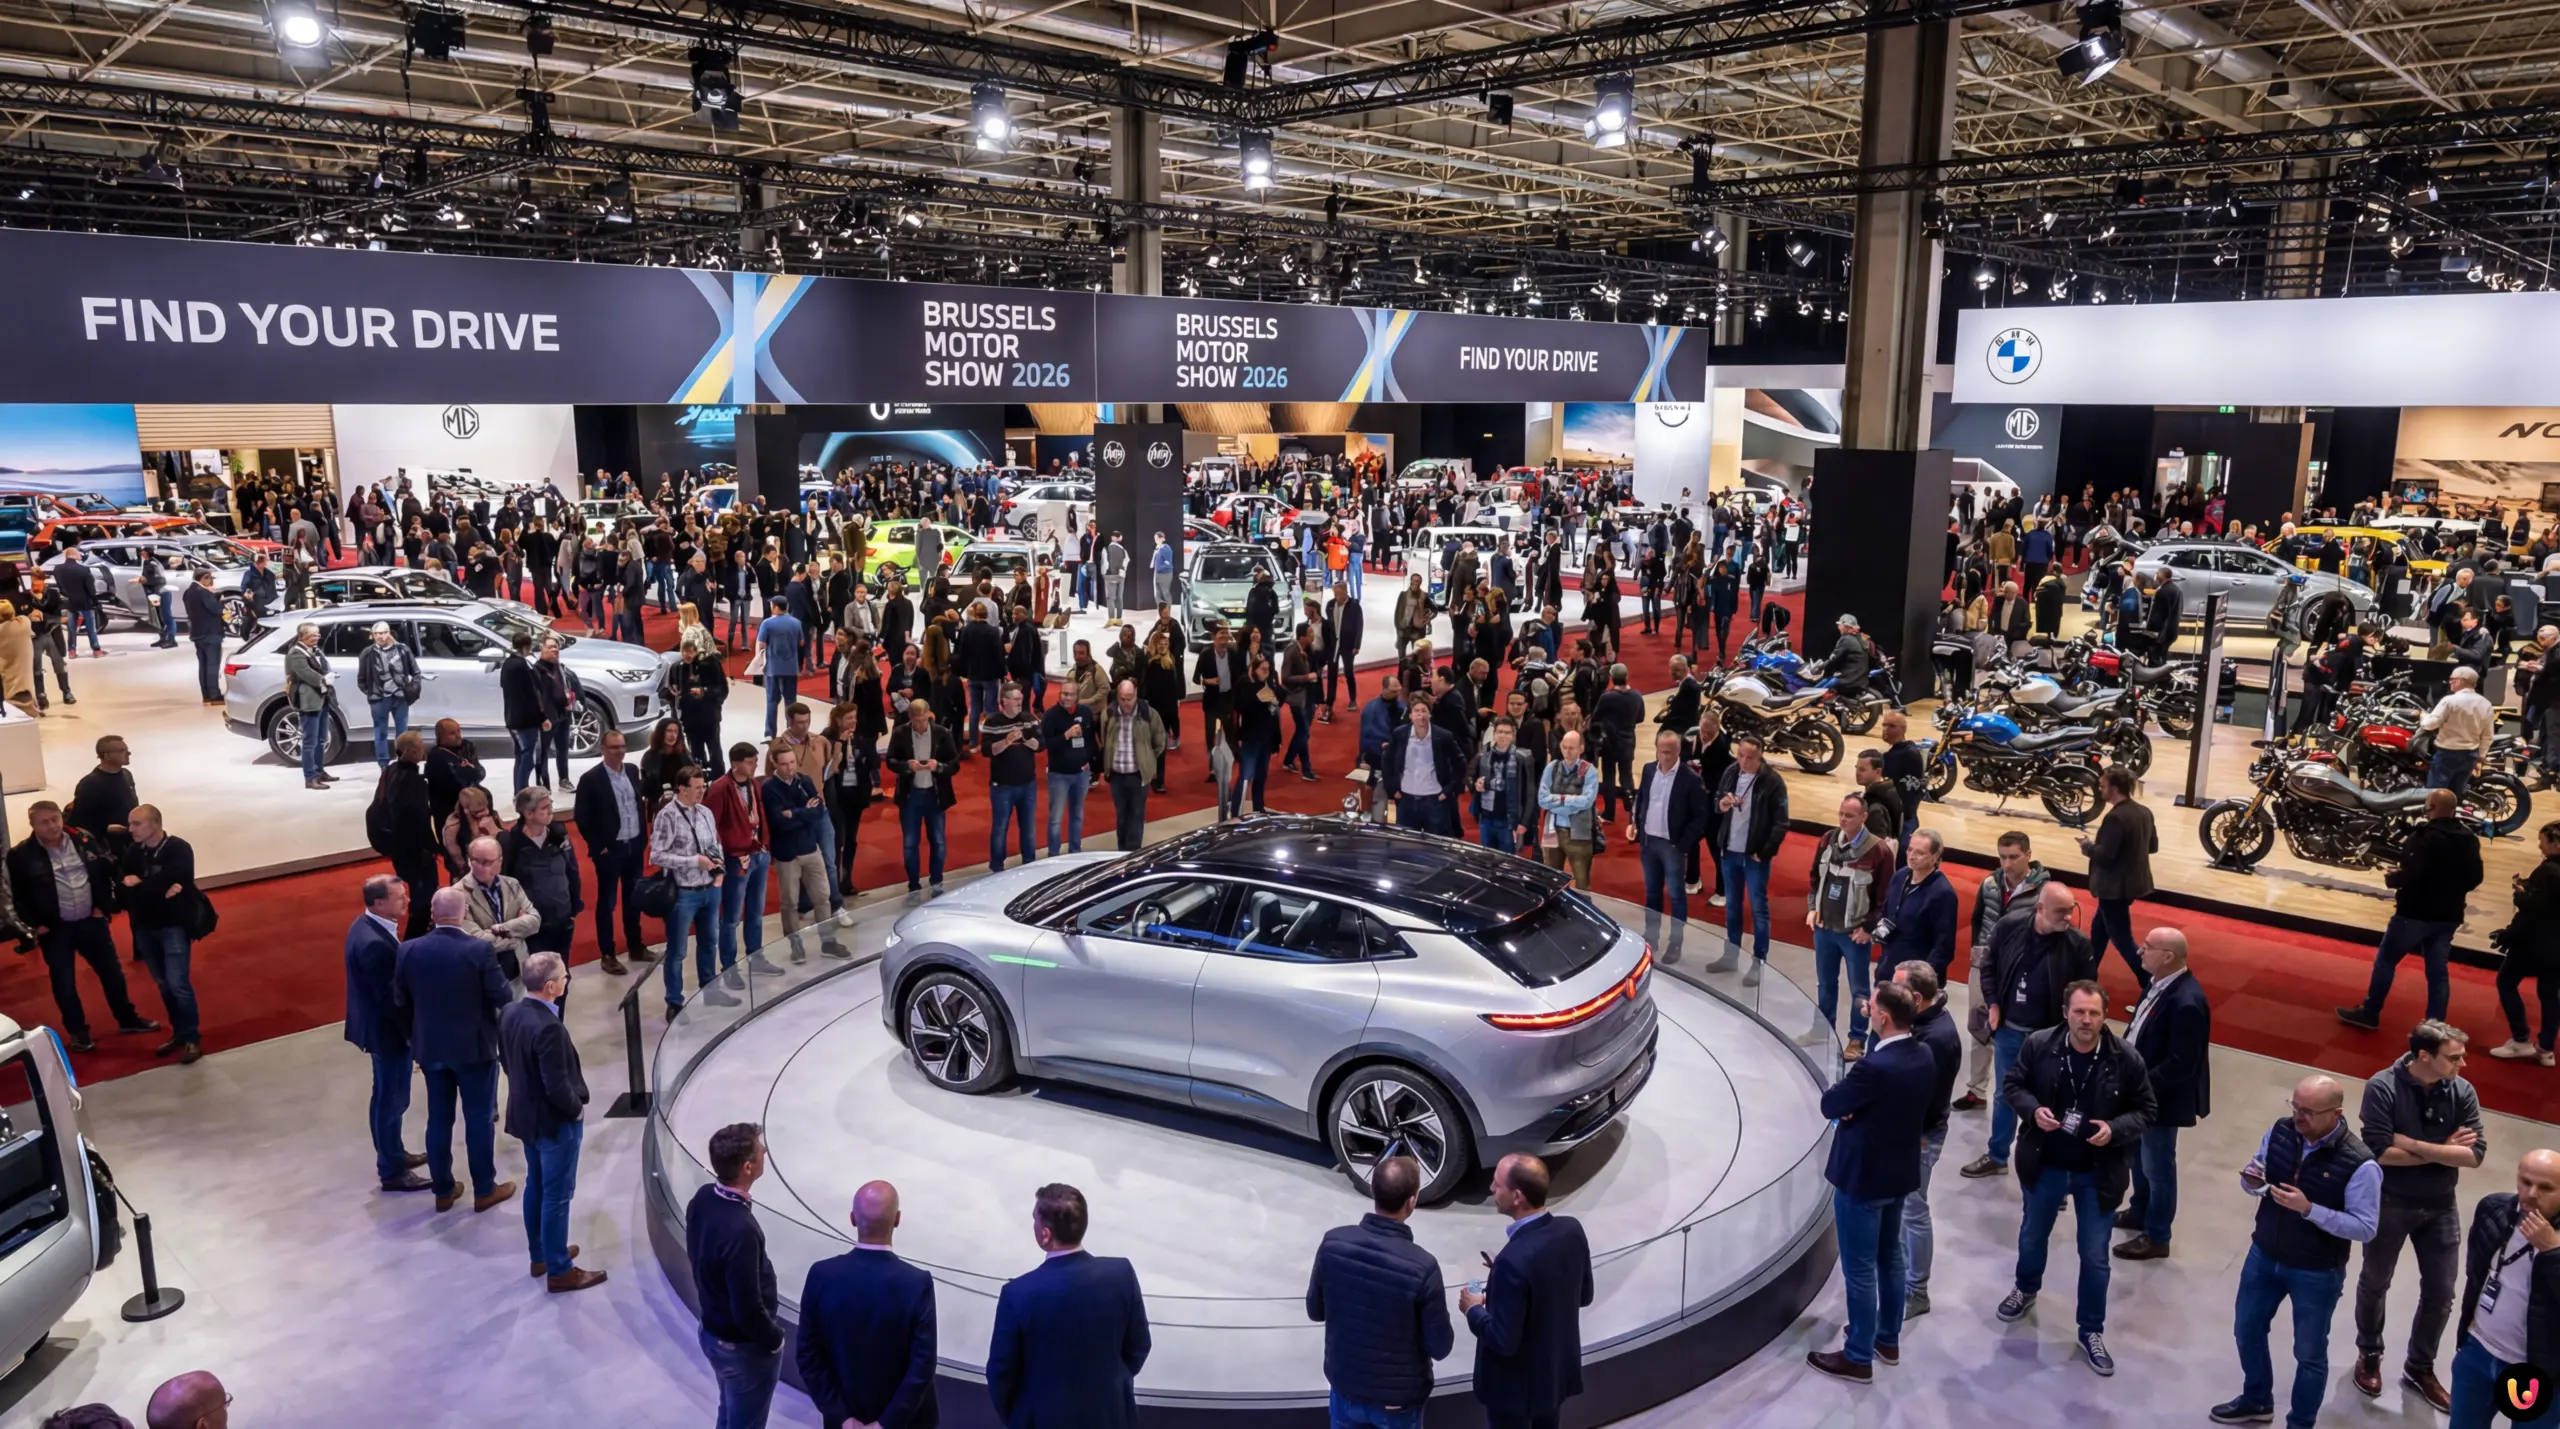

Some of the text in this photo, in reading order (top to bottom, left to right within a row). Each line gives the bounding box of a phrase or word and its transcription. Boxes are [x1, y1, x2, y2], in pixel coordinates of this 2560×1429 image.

[81, 296, 560, 352] FIND YOUR DRIVE
[923, 300, 1056, 332] BRUSSELS
[1176, 312, 1278, 340] BRUSSELS
[924, 330, 1020, 359] MOTOR
[1176, 339, 1249, 364] MOTOR
[1459, 346, 1599, 373] FIND YOUR DRIVE
[925, 360, 1070, 388] SHOW 2026
[1176, 364, 1288, 389] SHOW 2026
[446, 407, 476, 436] MG
[2008, 411, 2036, 437] MG
